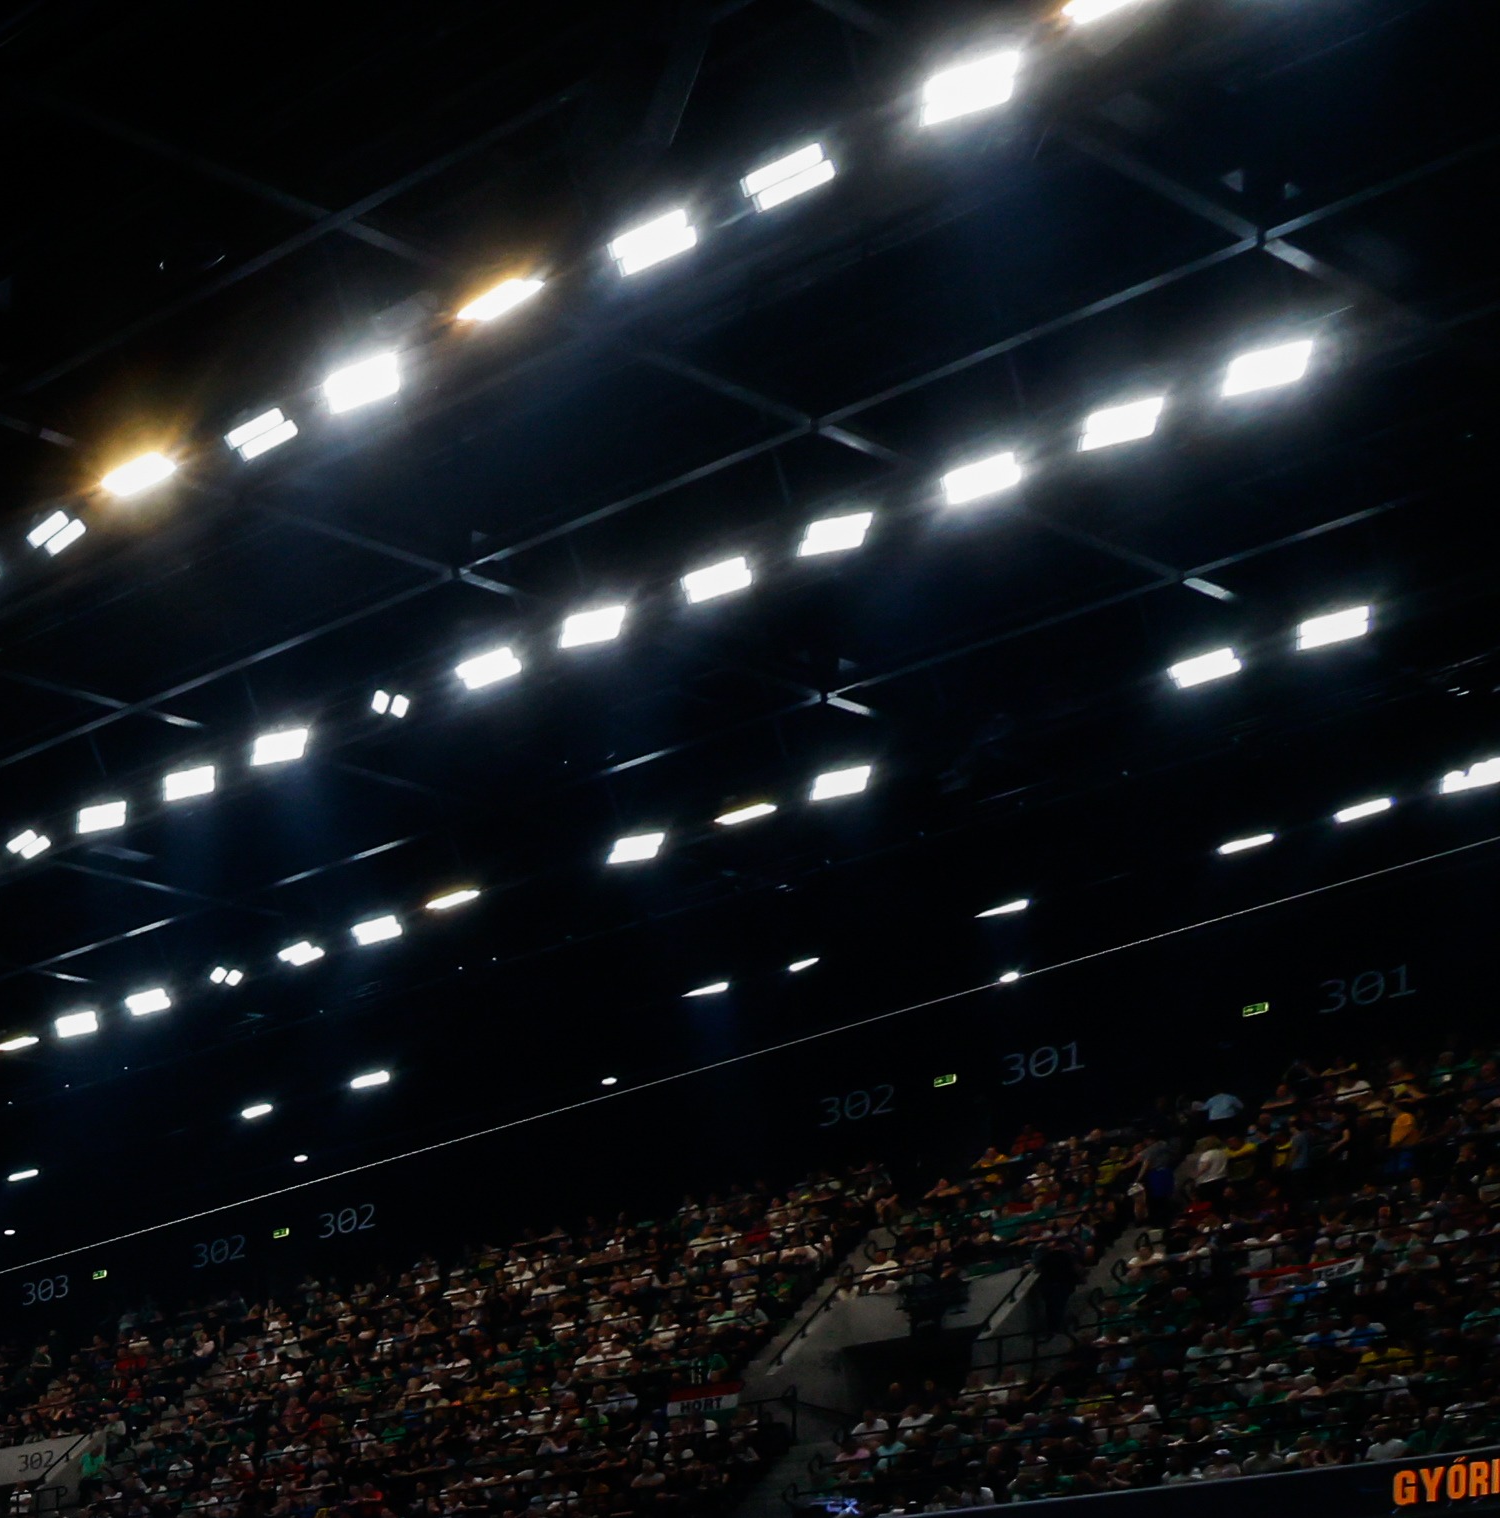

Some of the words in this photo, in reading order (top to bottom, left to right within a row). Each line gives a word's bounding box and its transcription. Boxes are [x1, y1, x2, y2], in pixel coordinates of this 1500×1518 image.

[1318, 963, 1417, 1014] 301
[1001, 1041, 1086, 1086] 301
[819, 1083, 895, 1127] 302
[318, 1203, 377, 1239] 302
[192, 1234, 247, 1268] 302
[21, 1275, 69, 1306] 303
[18, 1450, 55, 1472] 302
[1393, 1456, 1500, 1506] GYŐRI
